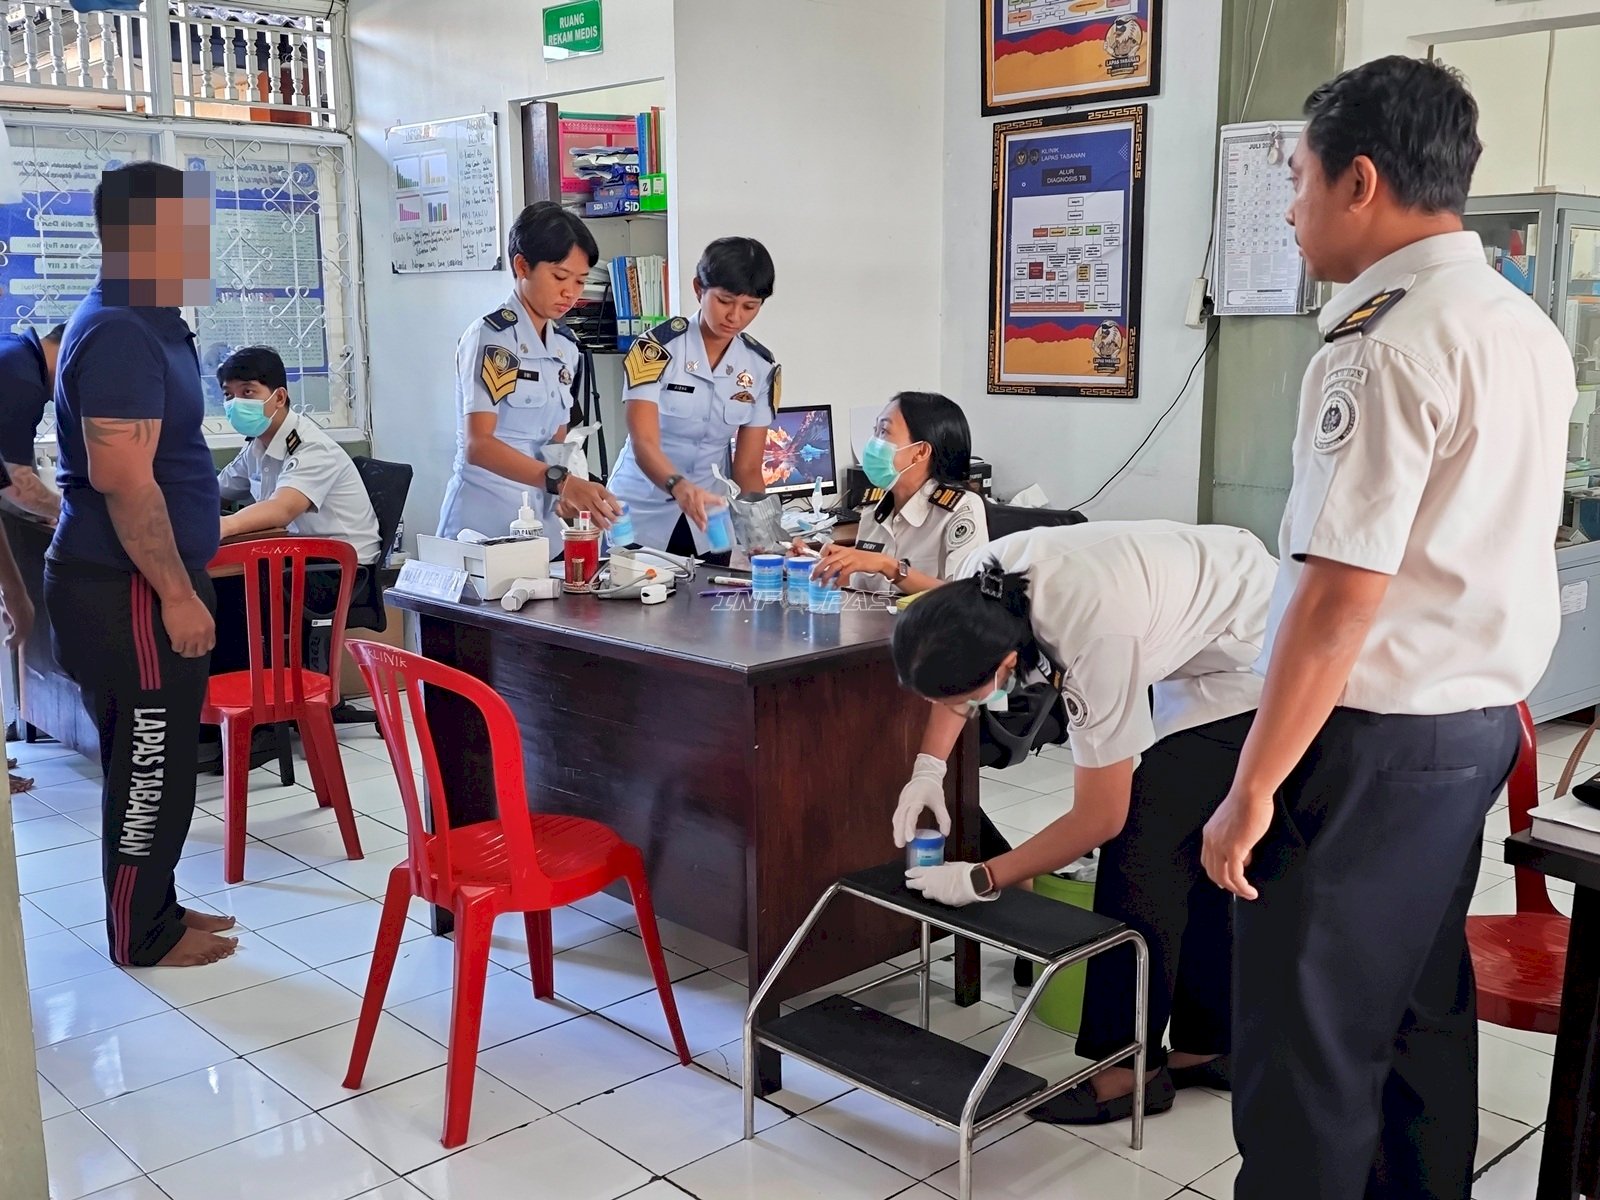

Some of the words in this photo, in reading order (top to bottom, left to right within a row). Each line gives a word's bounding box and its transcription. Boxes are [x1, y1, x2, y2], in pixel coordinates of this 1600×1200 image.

[560, 12, 585, 29] RUANG
[548, 31, 573, 46] REKAM
[575, 25, 598, 41] MEDIS
[1041, 147, 1060, 155] KLINIK
[1041, 154, 1059, 162] LAPAS
[1060, 151, 1086, 160] TABANAN
[625, 165, 640, 174] SiD
[1058, 168, 1075, 176] ALUR
[1046, 175, 1078, 184] DIAGNOSIS
[1079, 174, 1087, 182] TB
[624, 201, 640, 212] SiD
[250, 546, 301, 556] KLINIK
[862, 542, 877, 550] DEBY
[132, 707, 167, 767] LAPAS
[118, 769, 165, 857] TABANAN
